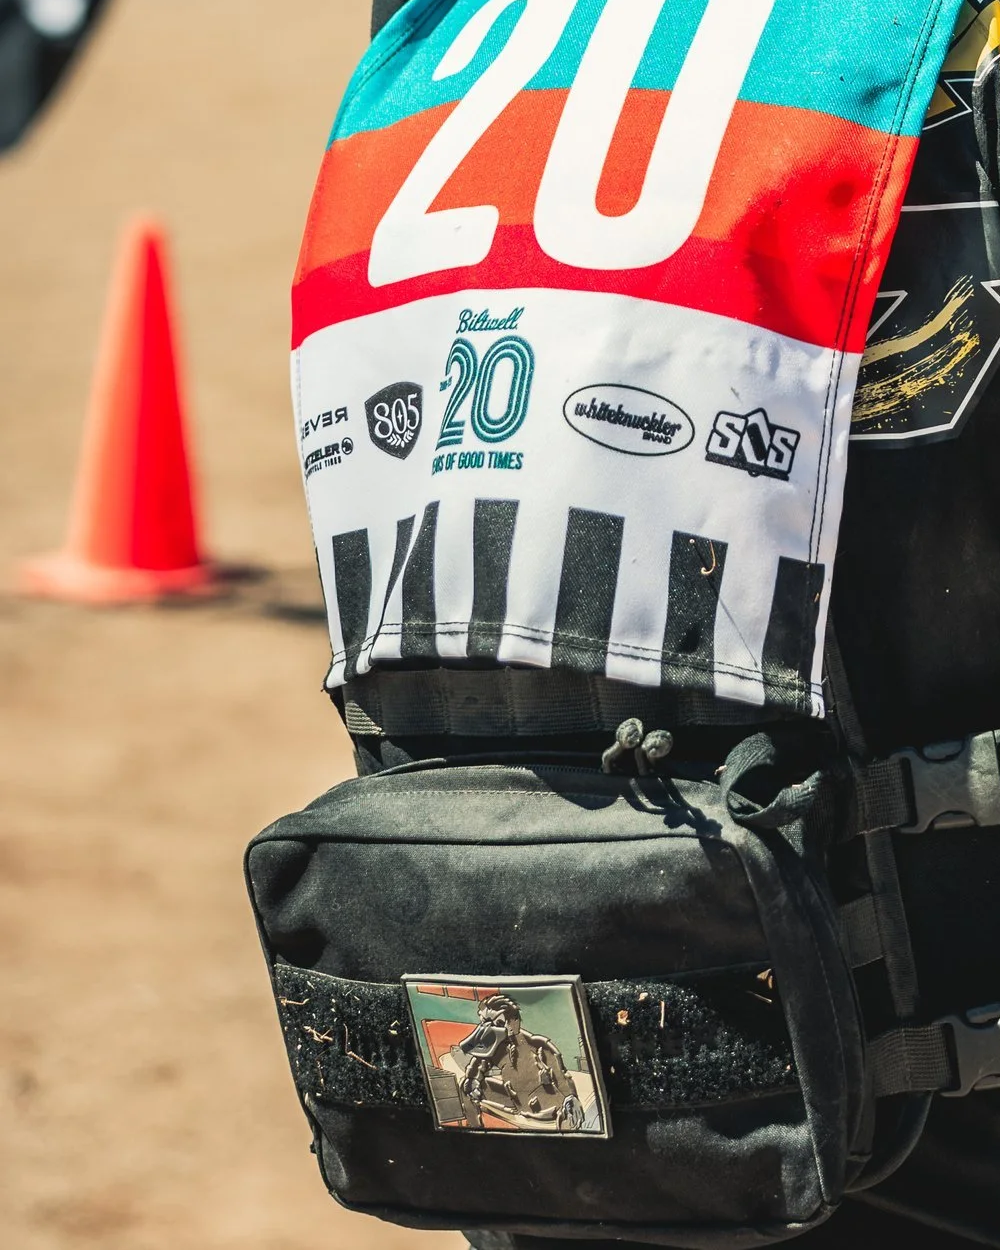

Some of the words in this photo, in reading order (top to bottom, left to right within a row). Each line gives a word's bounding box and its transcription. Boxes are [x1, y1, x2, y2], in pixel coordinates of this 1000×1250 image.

[456, 307, 525, 334] Biltwell
[435, 335, 536, 452] 20
[373, 393, 420, 439] 805
[642, 431, 672, 445] BRAND
[445, 452, 458, 471] OF
[458, 451, 485, 470] GOOD
[488, 451, 524, 471] TIMES
